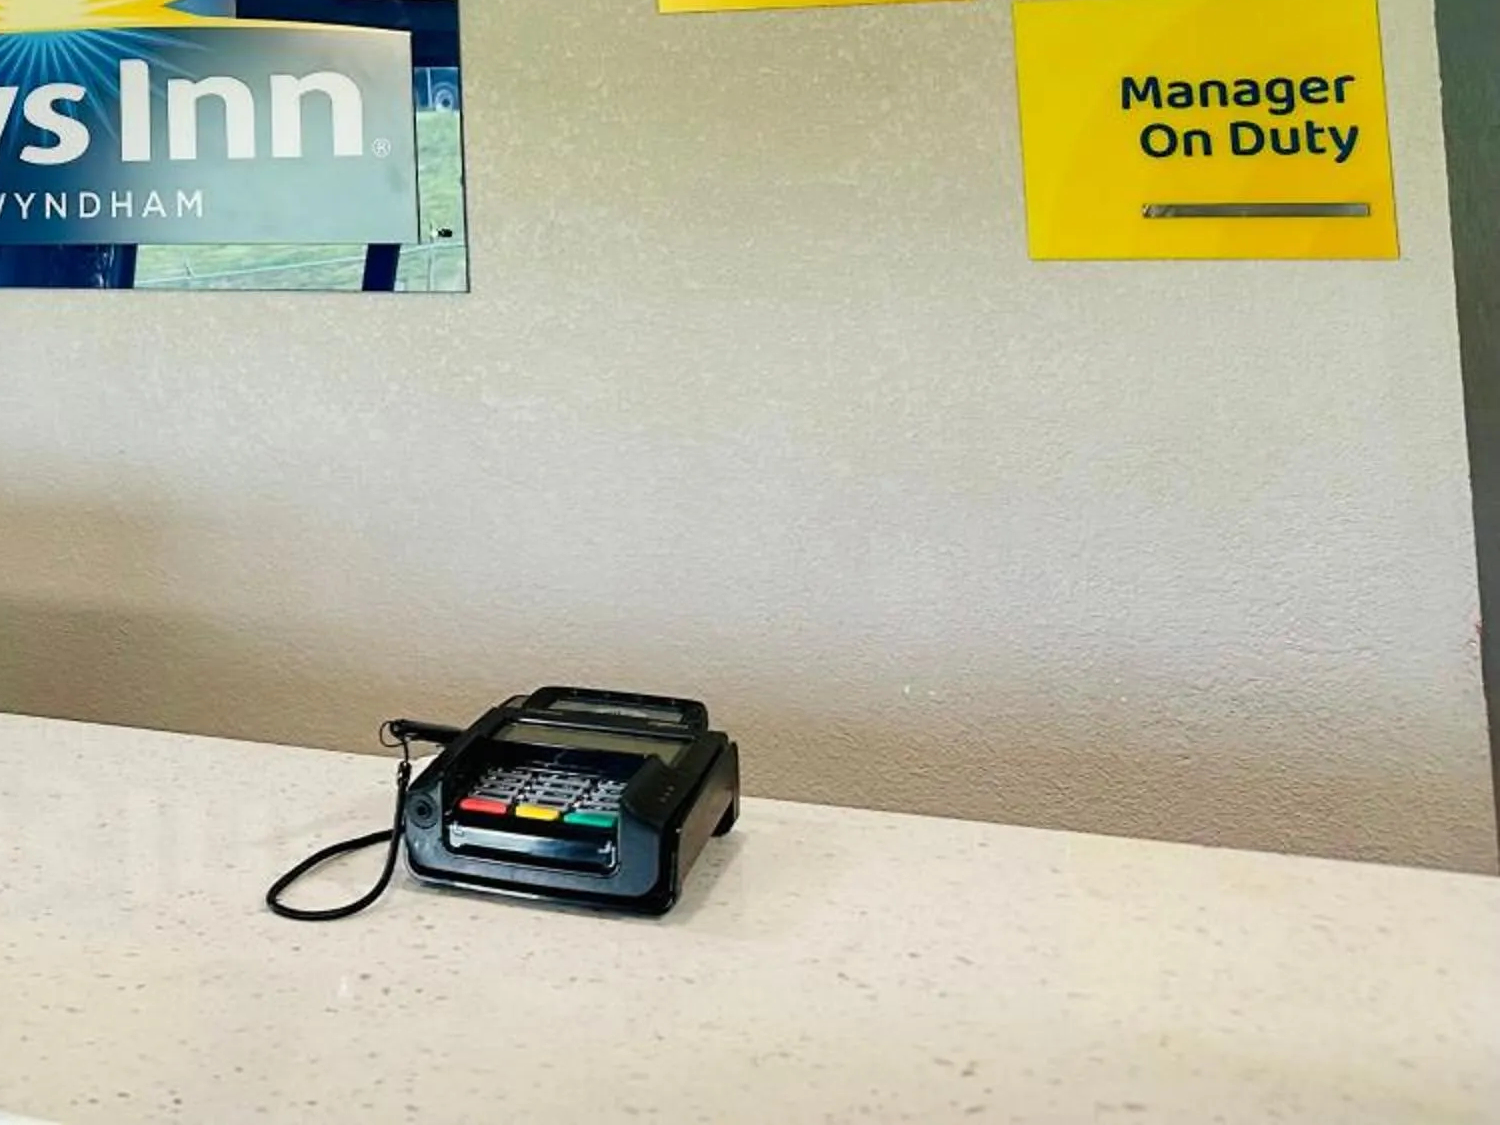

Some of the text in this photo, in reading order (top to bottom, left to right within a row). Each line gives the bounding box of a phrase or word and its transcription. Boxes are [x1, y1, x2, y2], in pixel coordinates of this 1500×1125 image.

[119, 58, 364, 162] Inn
[1121, 74, 1355, 116] Manager
[1140, 120, 1359, 164] On Duty
